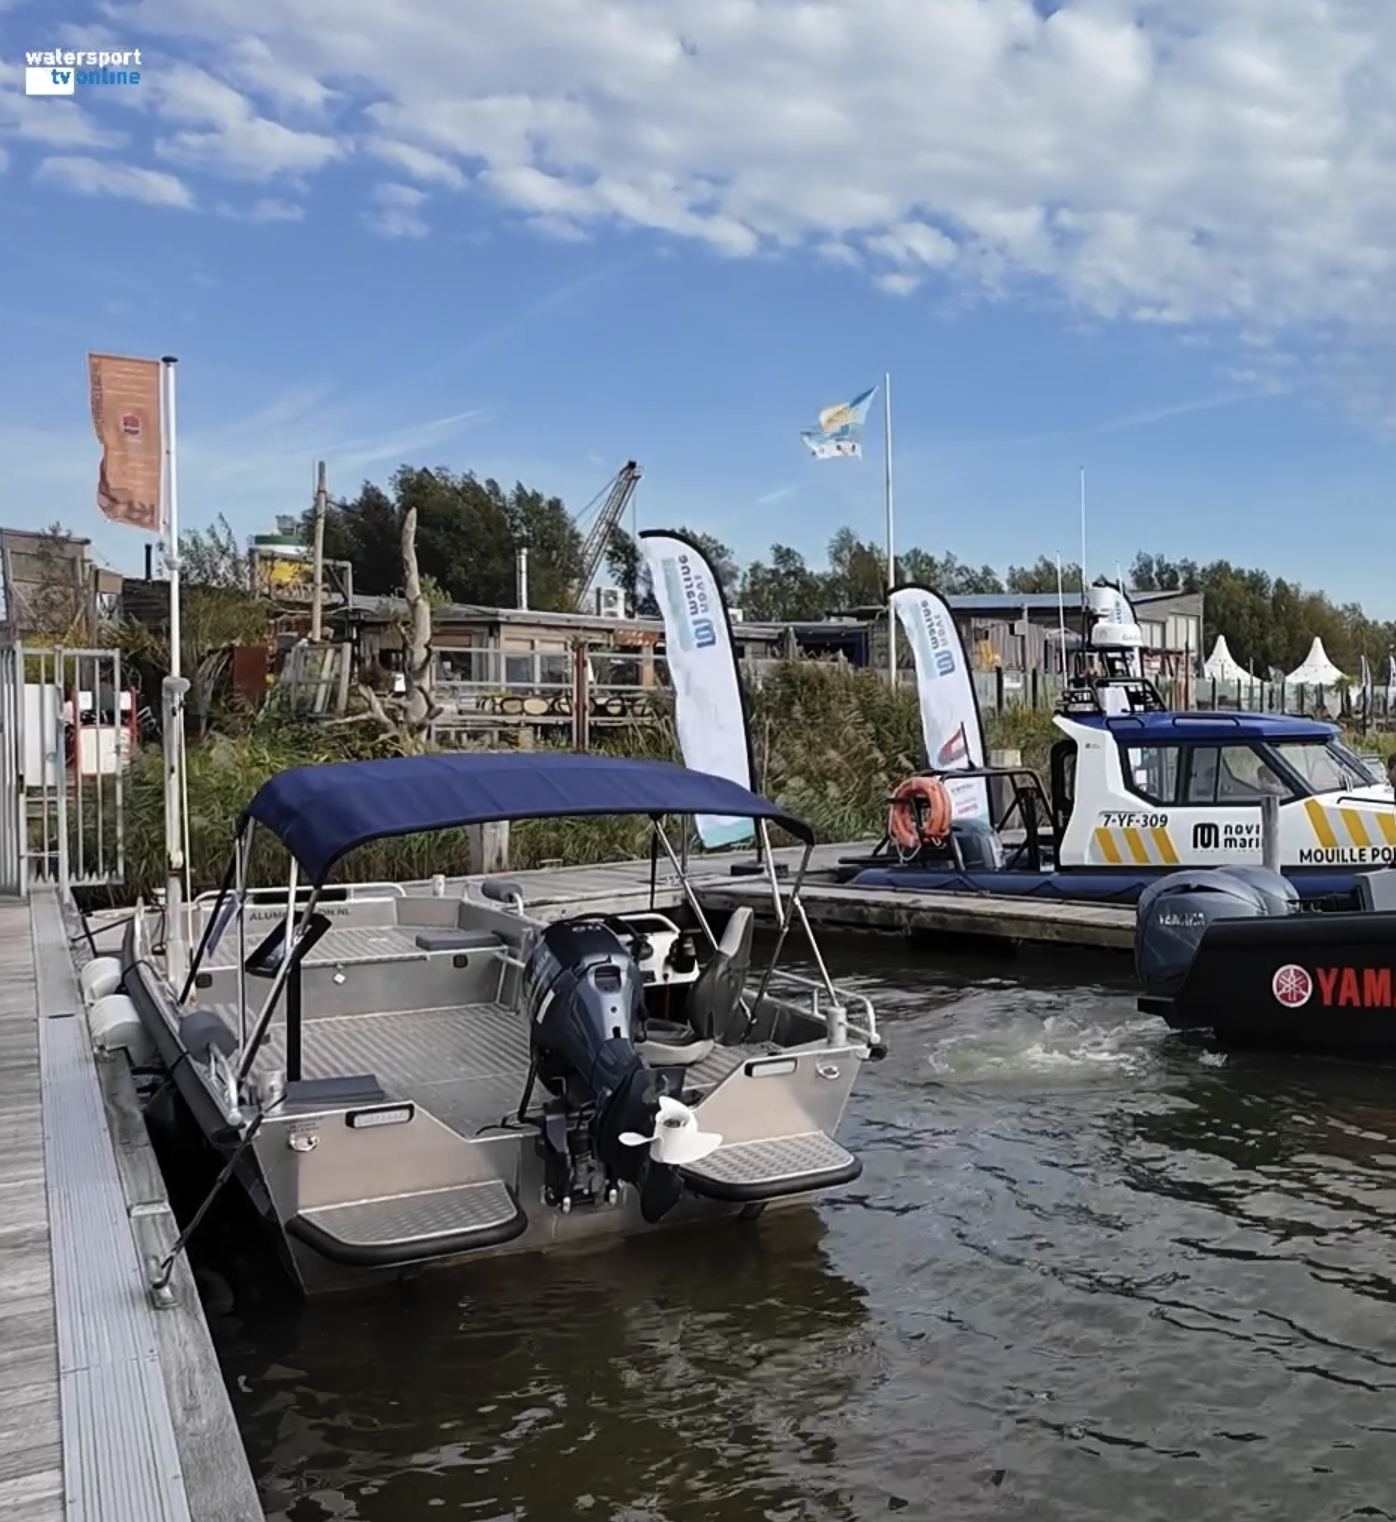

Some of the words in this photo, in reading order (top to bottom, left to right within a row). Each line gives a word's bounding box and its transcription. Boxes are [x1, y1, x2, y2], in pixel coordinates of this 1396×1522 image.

[678, 554, 699, 616] marine
[1103, 814, 1169, 828] 7-YF-309
[1224, 824, 1260, 835] novi
[1224, 837, 1260, 848] mari
[1300, 847, 1367, 864] MOUILLE
